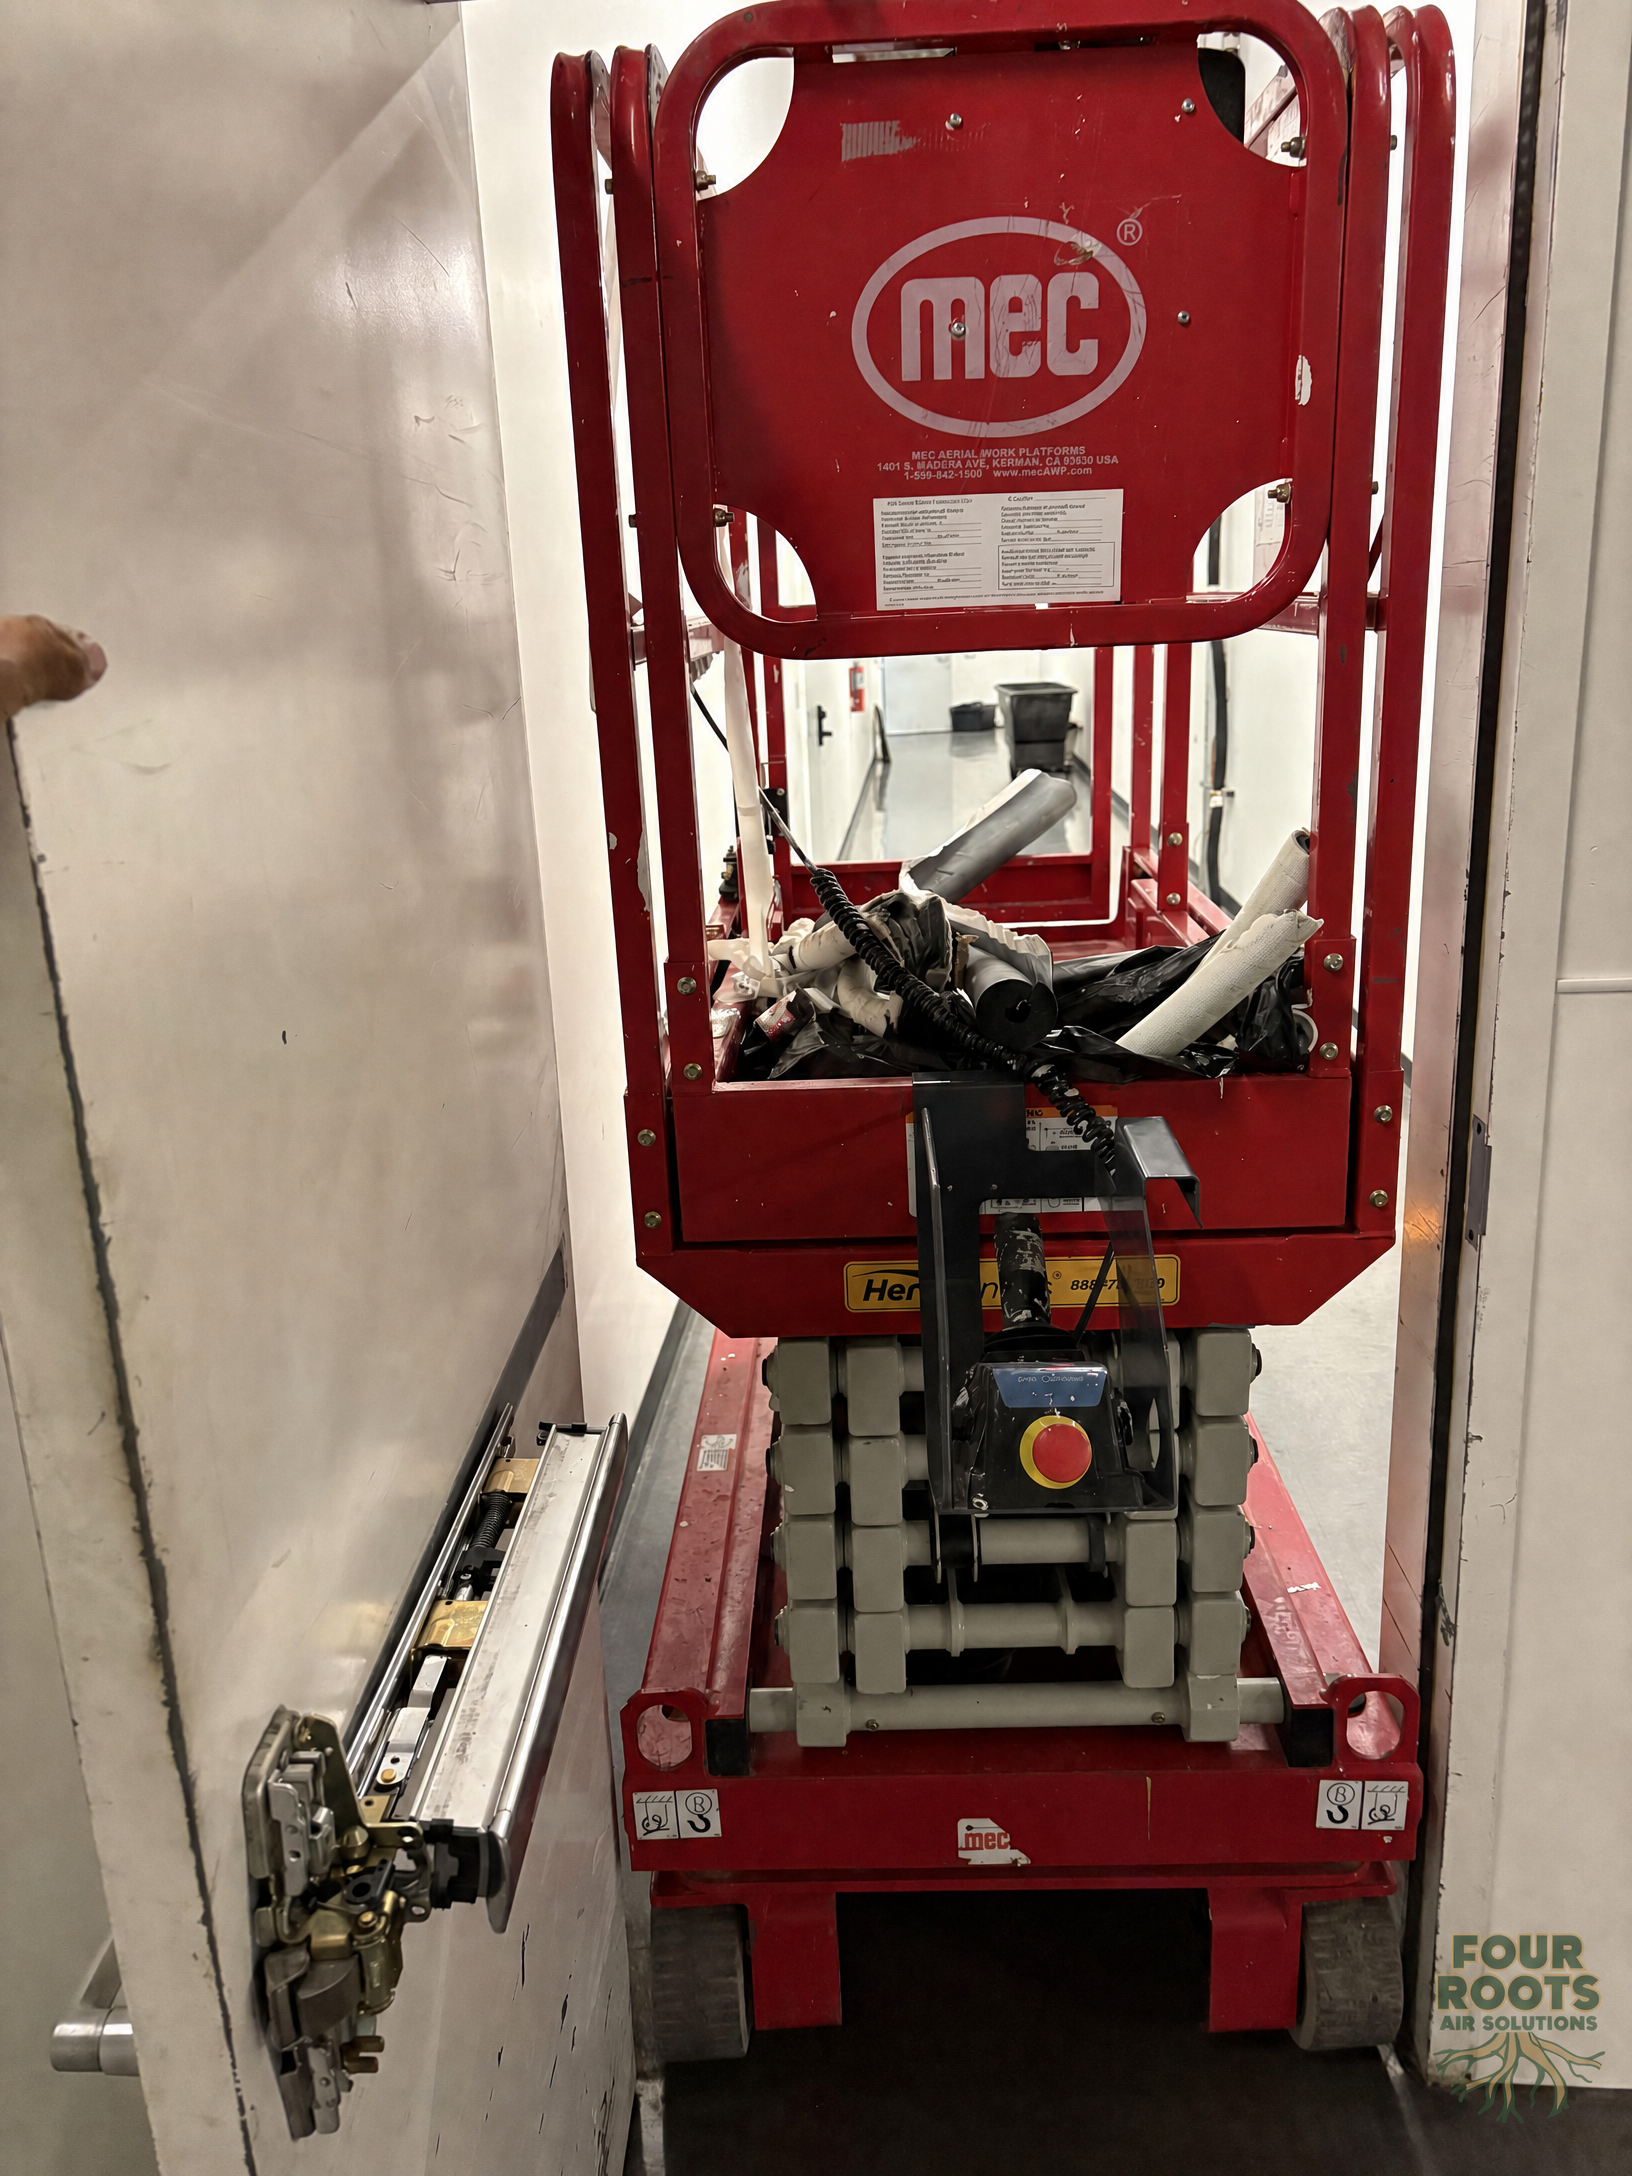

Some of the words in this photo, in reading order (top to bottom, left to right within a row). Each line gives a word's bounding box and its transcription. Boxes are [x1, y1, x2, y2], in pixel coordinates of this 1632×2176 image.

[911, 450, 936, 460] MEC
[938, 449, 978, 459] AERIAL
[980, 448, 1016, 459] WORK
[1018, 446, 1086, 457] PLATFORMS
[877, 462, 900, 471] 1401
[903, 462, 914, 471] S.
[917, 460, 963, 470] MADERA
[965, 459, 990, 470] AVE,
[1045, 456, 1061, 466] CA
[1096, 454, 1119, 465] USA
[993, 466, 1093, 477] www.mecAWP.com
[964, 1832, 1010, 1850] mec
